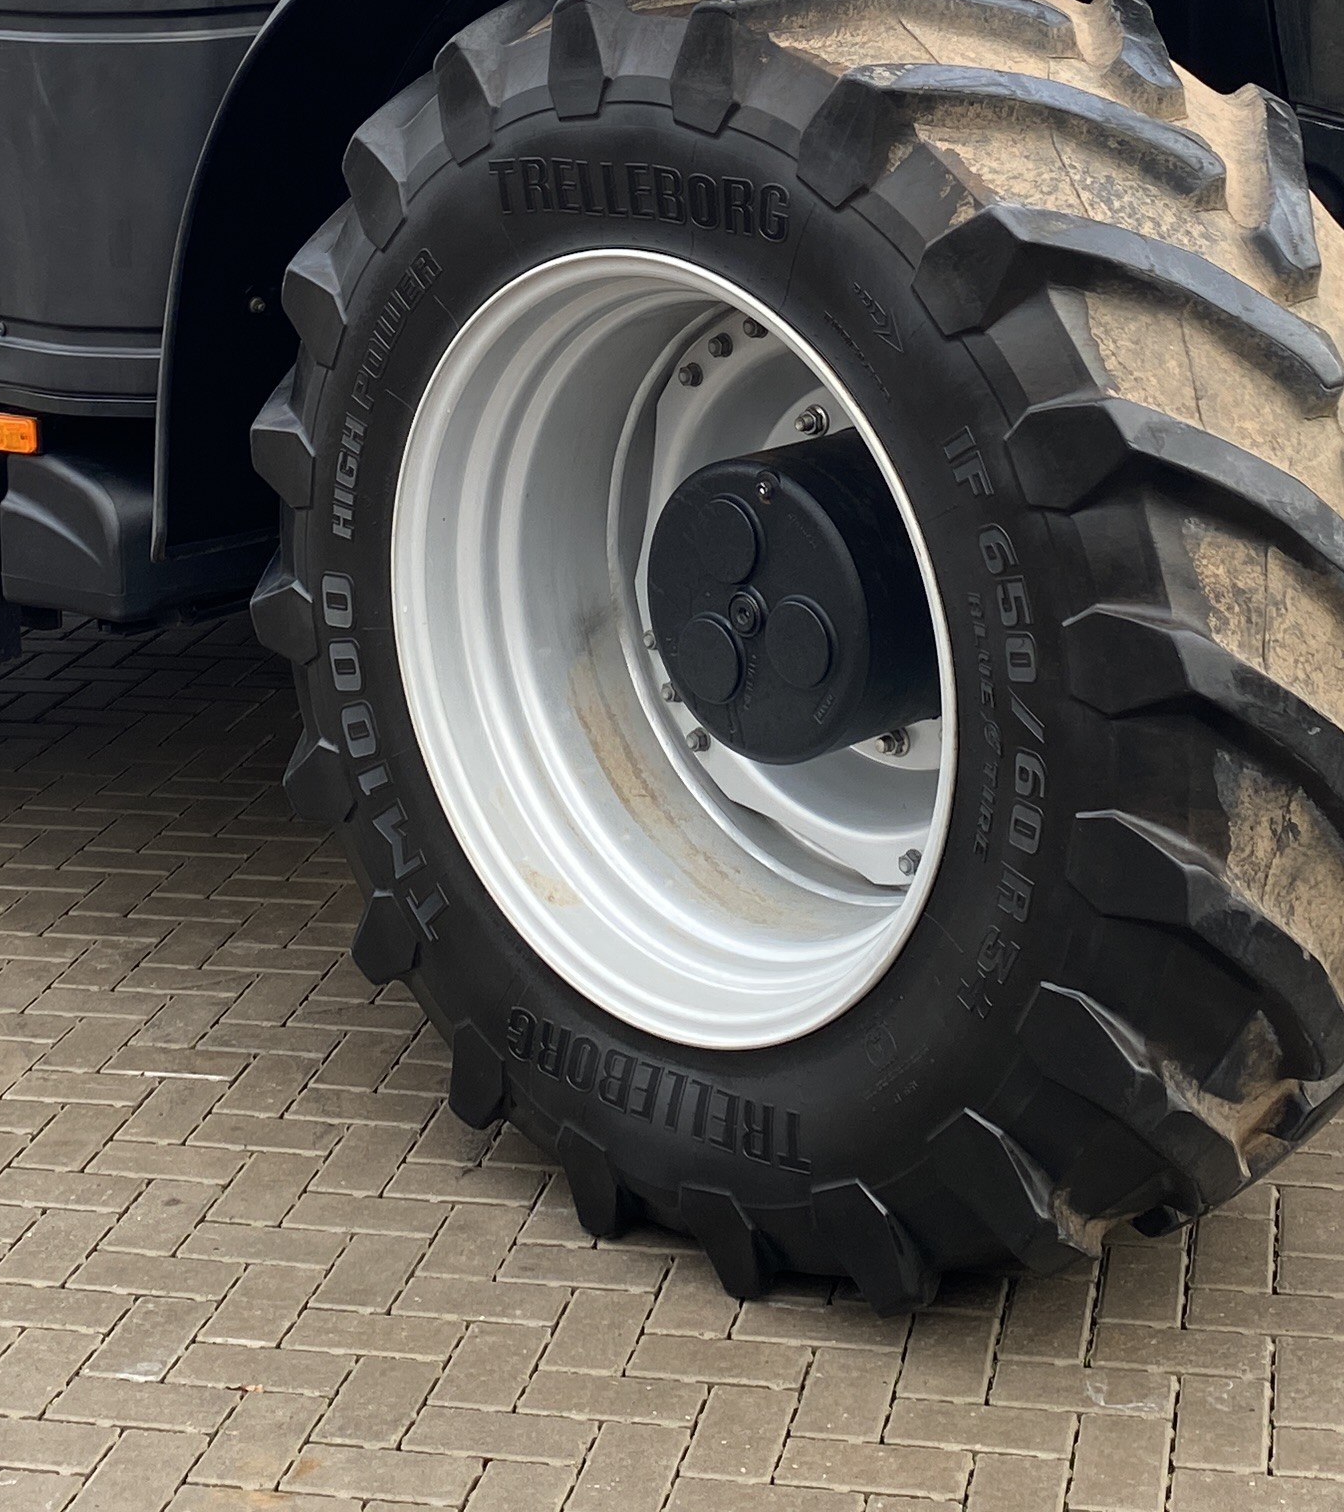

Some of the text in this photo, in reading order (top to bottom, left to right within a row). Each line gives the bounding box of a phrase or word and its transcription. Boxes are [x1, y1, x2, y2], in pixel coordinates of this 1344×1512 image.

[488, 156, 792, 243] TRELLEBORG
[331, 246, 444, 541] HIGH POWER
[943, 425, 995, 497] IF
[321, 571, 451, 943] TM1000
[978, 523, 1046, 856] 650/60
[997, 860, 1037, 925] R
[507, 1006, 812, 1176] TRELLEBORG
